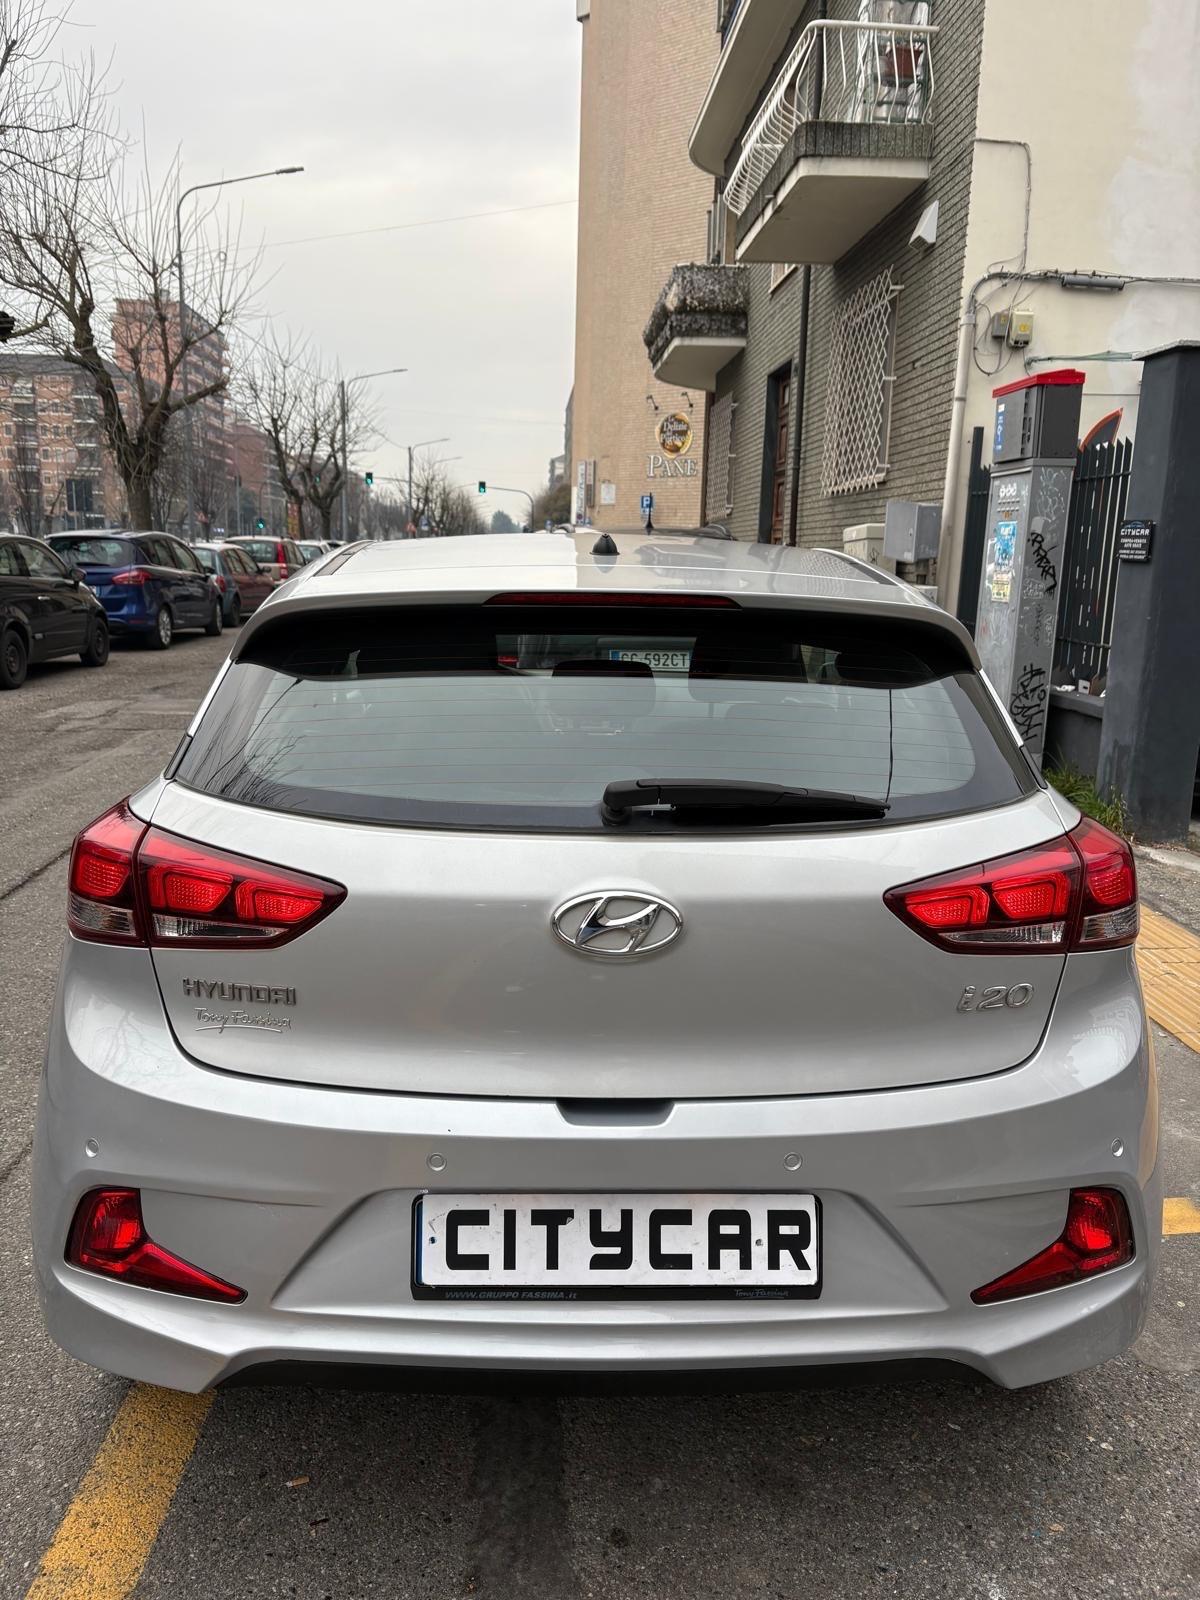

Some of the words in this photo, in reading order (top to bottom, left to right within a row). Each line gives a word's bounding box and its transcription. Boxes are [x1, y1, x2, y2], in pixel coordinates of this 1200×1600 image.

[648, 455, 697, 478] PANE
[642, 496, 651, 508] P
[1120, 528, 1150, 536] CITYCAR
[182, 978, 297, 1006] HYUNDAI
[957, 983, 1034, 1012] i20
[445, 1208, 812, 1271] CITYCAR
